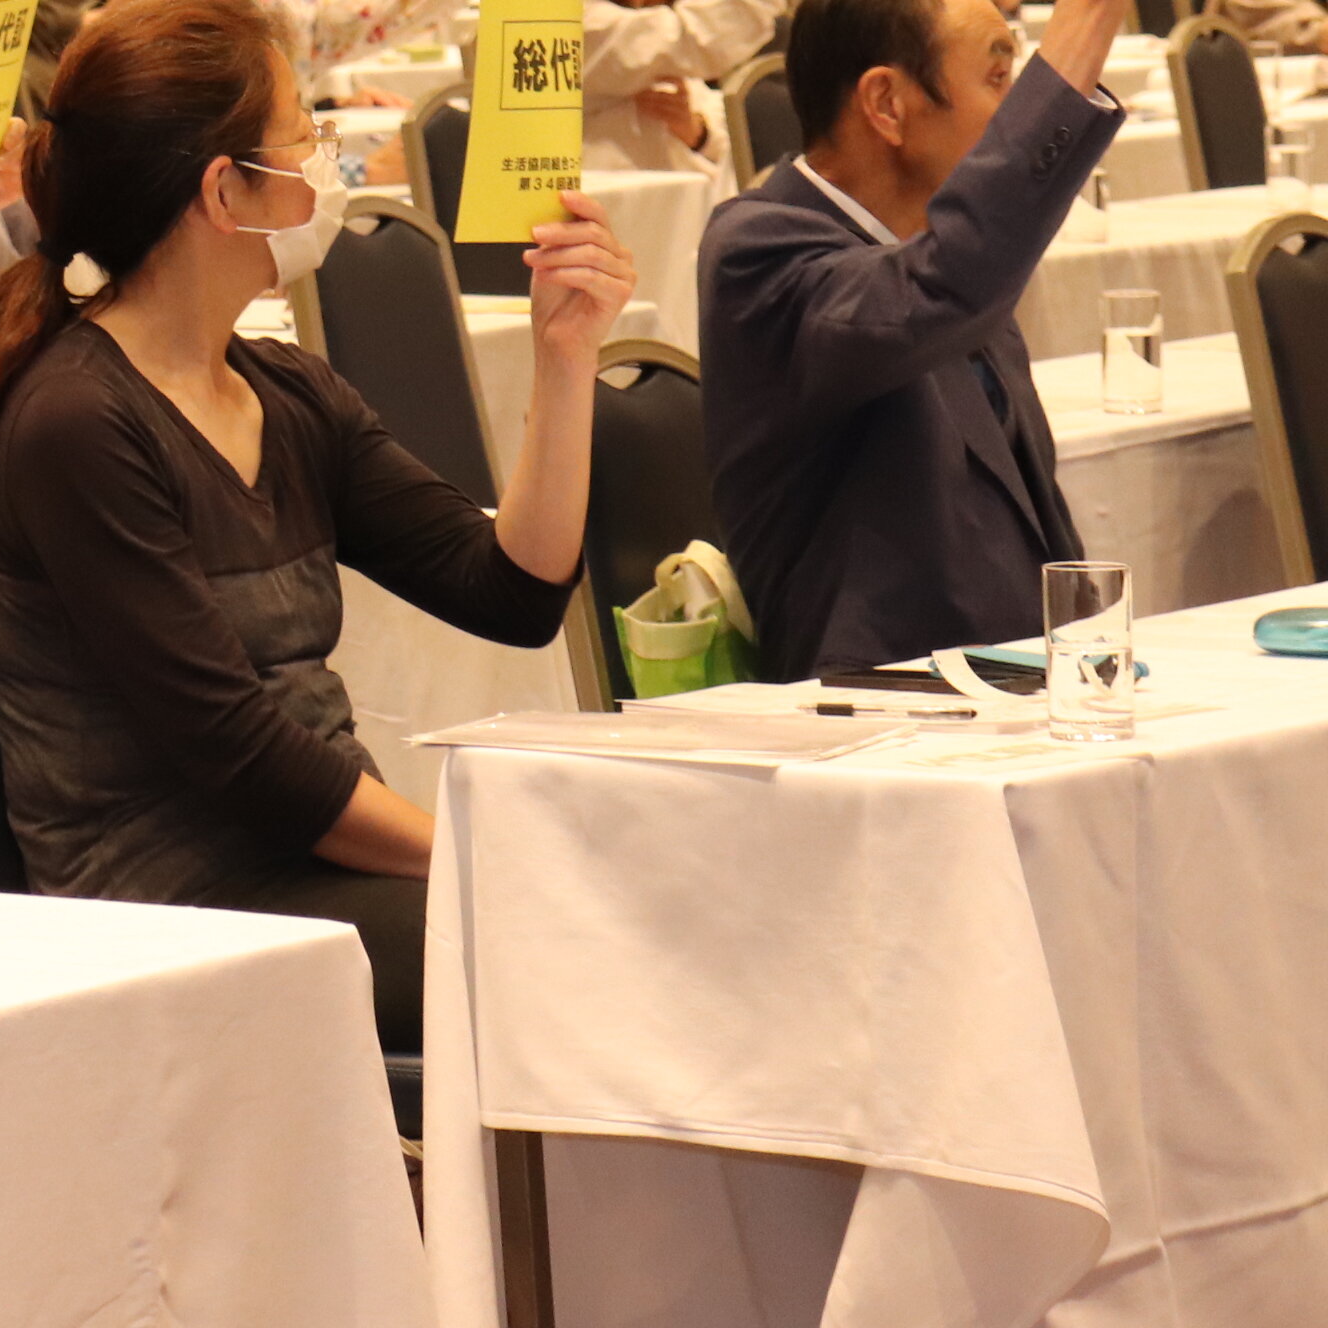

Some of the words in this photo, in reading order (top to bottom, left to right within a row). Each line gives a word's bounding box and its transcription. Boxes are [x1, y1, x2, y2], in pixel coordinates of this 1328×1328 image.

[501, 156, 582, 172] 生活協同組合コー
